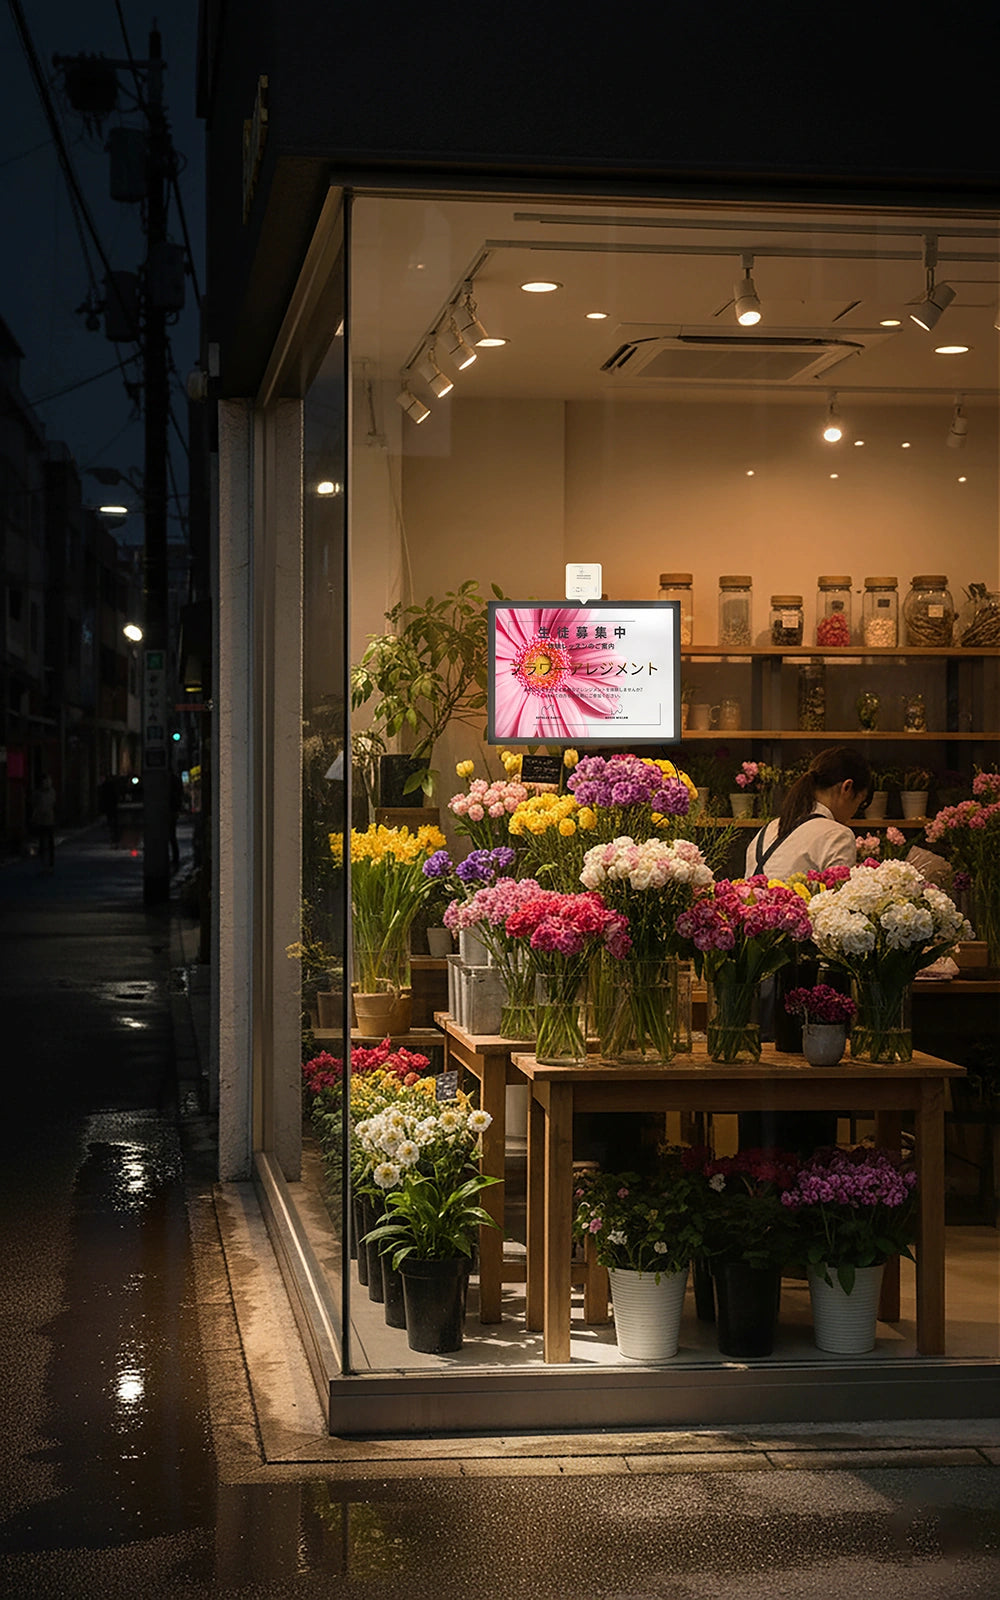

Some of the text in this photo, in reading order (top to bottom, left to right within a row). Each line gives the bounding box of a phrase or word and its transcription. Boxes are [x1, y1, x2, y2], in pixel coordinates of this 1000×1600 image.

[538, 626, 626, 639] 生徒募集中
[510, 661, 658, 676] フラワーアレジメント
